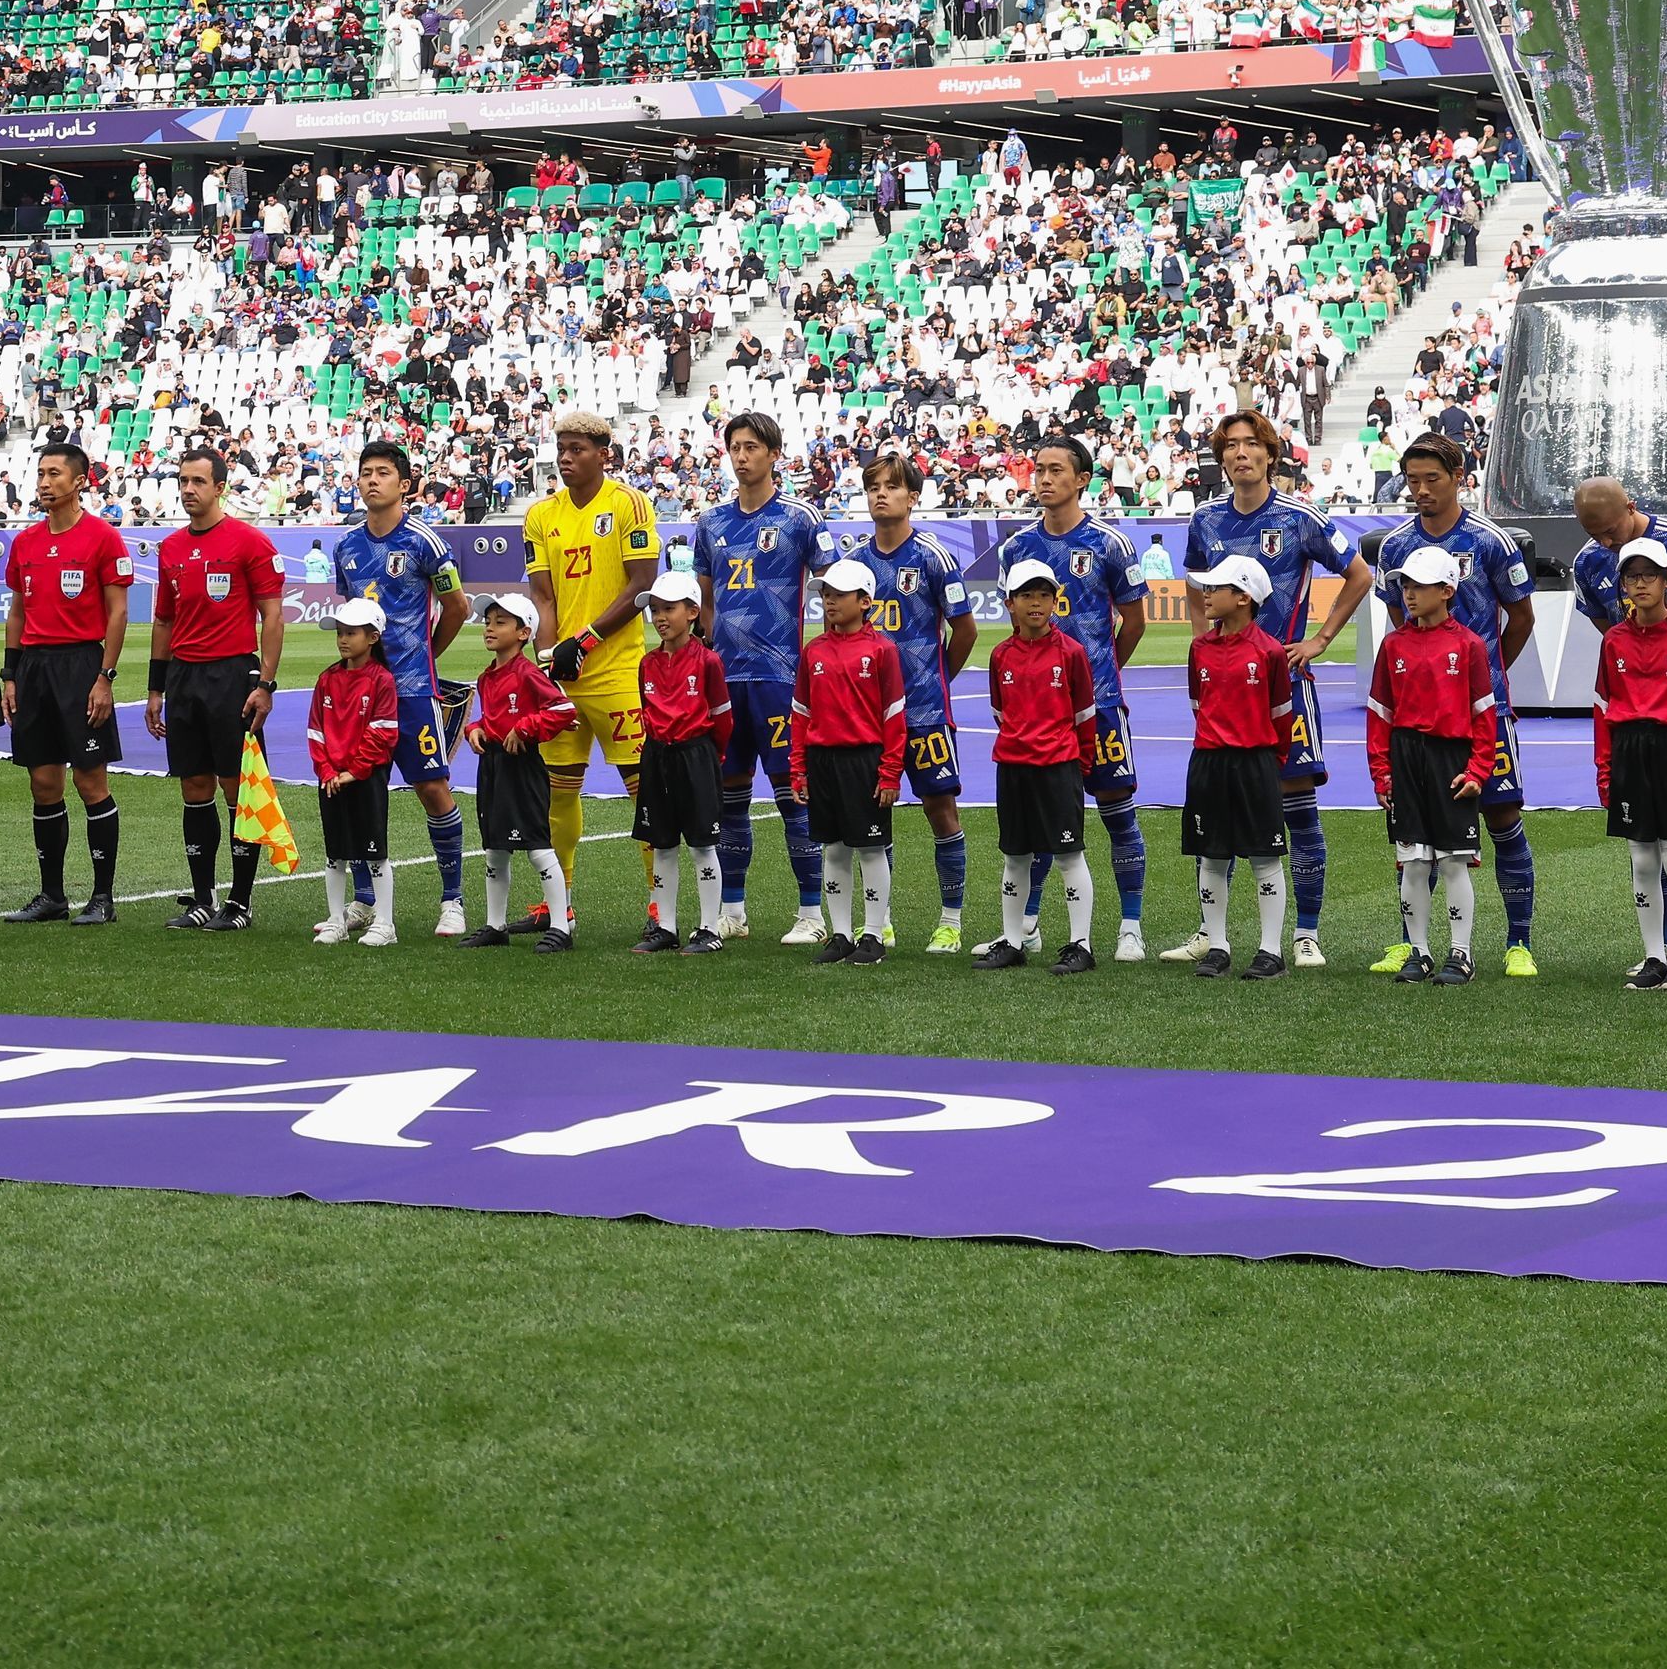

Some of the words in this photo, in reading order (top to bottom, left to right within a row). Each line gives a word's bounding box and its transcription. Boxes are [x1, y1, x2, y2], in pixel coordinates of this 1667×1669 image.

[938, 75, 1022, 95] #HayyaAsia
[295, 113, 360, 128] Education
[362, 111, 389, 128] City
[390, 107, 447, 123] Stadium
[63, 572, 82, 580] FIFA
[208, 575, 228, 583] FIFA
[564, 546, 592, 580] 23
[727, 558, 755, 591] 21
[870, 599, 902, 632] 20
[418, 725, 437, 756] 6
[608, 707, 643, 742] 23
[910, 732, 950, 771] 20
[1095, 728, 1125, 767] 16
